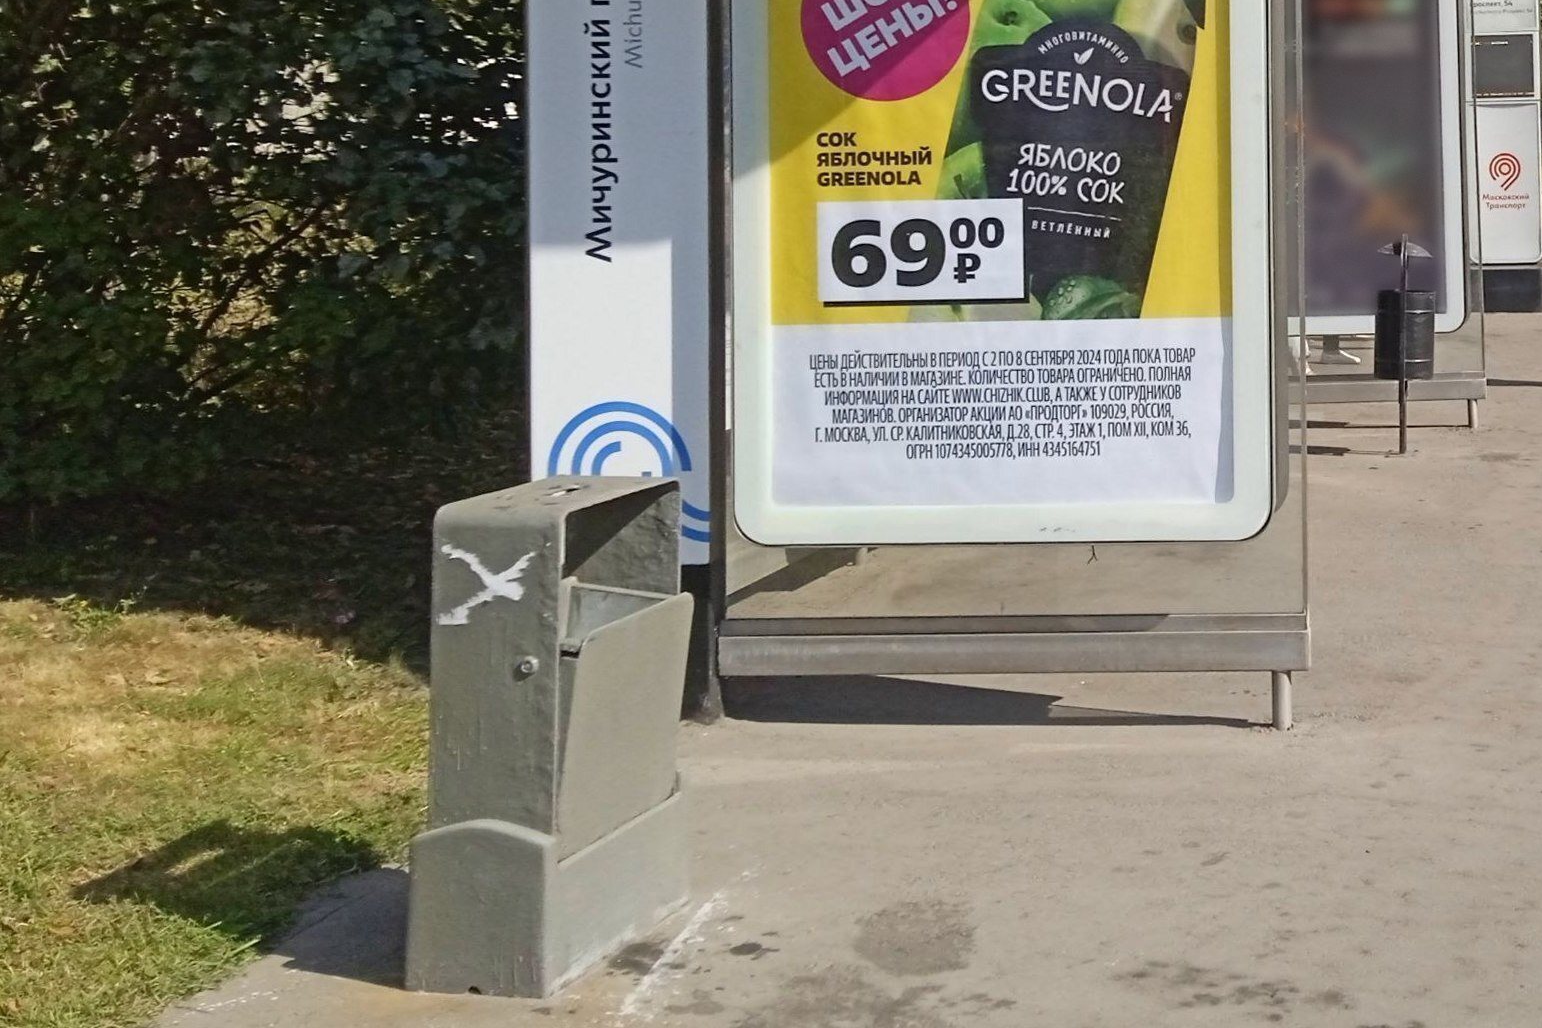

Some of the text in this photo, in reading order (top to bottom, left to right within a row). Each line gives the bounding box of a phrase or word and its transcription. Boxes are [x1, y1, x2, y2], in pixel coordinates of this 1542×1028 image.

[1037, 30, 1129, 64] МНОГОВИТАМИННО
[584, 19, 619, 263] Мичуринский
[816, 131, 857, 148] СОК
[816, 146, 932, 167] ЯБЛОЧНЫЙ
[1017, 142, 1122, 176] ЯБЛОКО
[816, 170, 922, 187] GREENOLA
[1006, 168, 1126, 204] 100% СОК
[810, 348, 1196, 371] ЦЕНЫ ДЕЙСТВИТЕЛЬНЫ В ПЕРИОД С 2 ПО 8 СЕНТЯБРЯ 2024 ГОДА ПОКА ТОВАР
[814, 366, 1191, 388] ЕСТЬ В НАЛИЧИИ В МАГАЗИНЕ. КОЛИЧЕСТВО ТОВАРА ОГРАНИЧЕНО. ПОЛНАЯ
[824, 389, 899, 407] ИНФОРМАЦИЯ
[901, 389, 915, 404] НА
[918, 386, 950, 404] САЙТЕ
[1055, 387, 1062, 402] А
[1064, 386, 1098, 402] ТАКЖЕ
[1100, 385, 1106, 401] У
[1108, 384, 1182, 402] СОТРУДНИКОВ
[832, 403, 1174, 424] МАГАЗИНОВ. ОРГАНИЗАТОР АКЦИИ АО «ПРОДТОРГ» 109029, РОССИЯ,
[815, 420, 1192, 444] Г. МОСКВА, УЛ. СР. КАЛИТНИКОВСКАЯ, Д.28, СТР. 4, ЭТАЖ 1, ПОМ XII, КОМ 36,
[906, 440, 1100, 460] ОГРН 1074345005778, ИНН 4345164751
